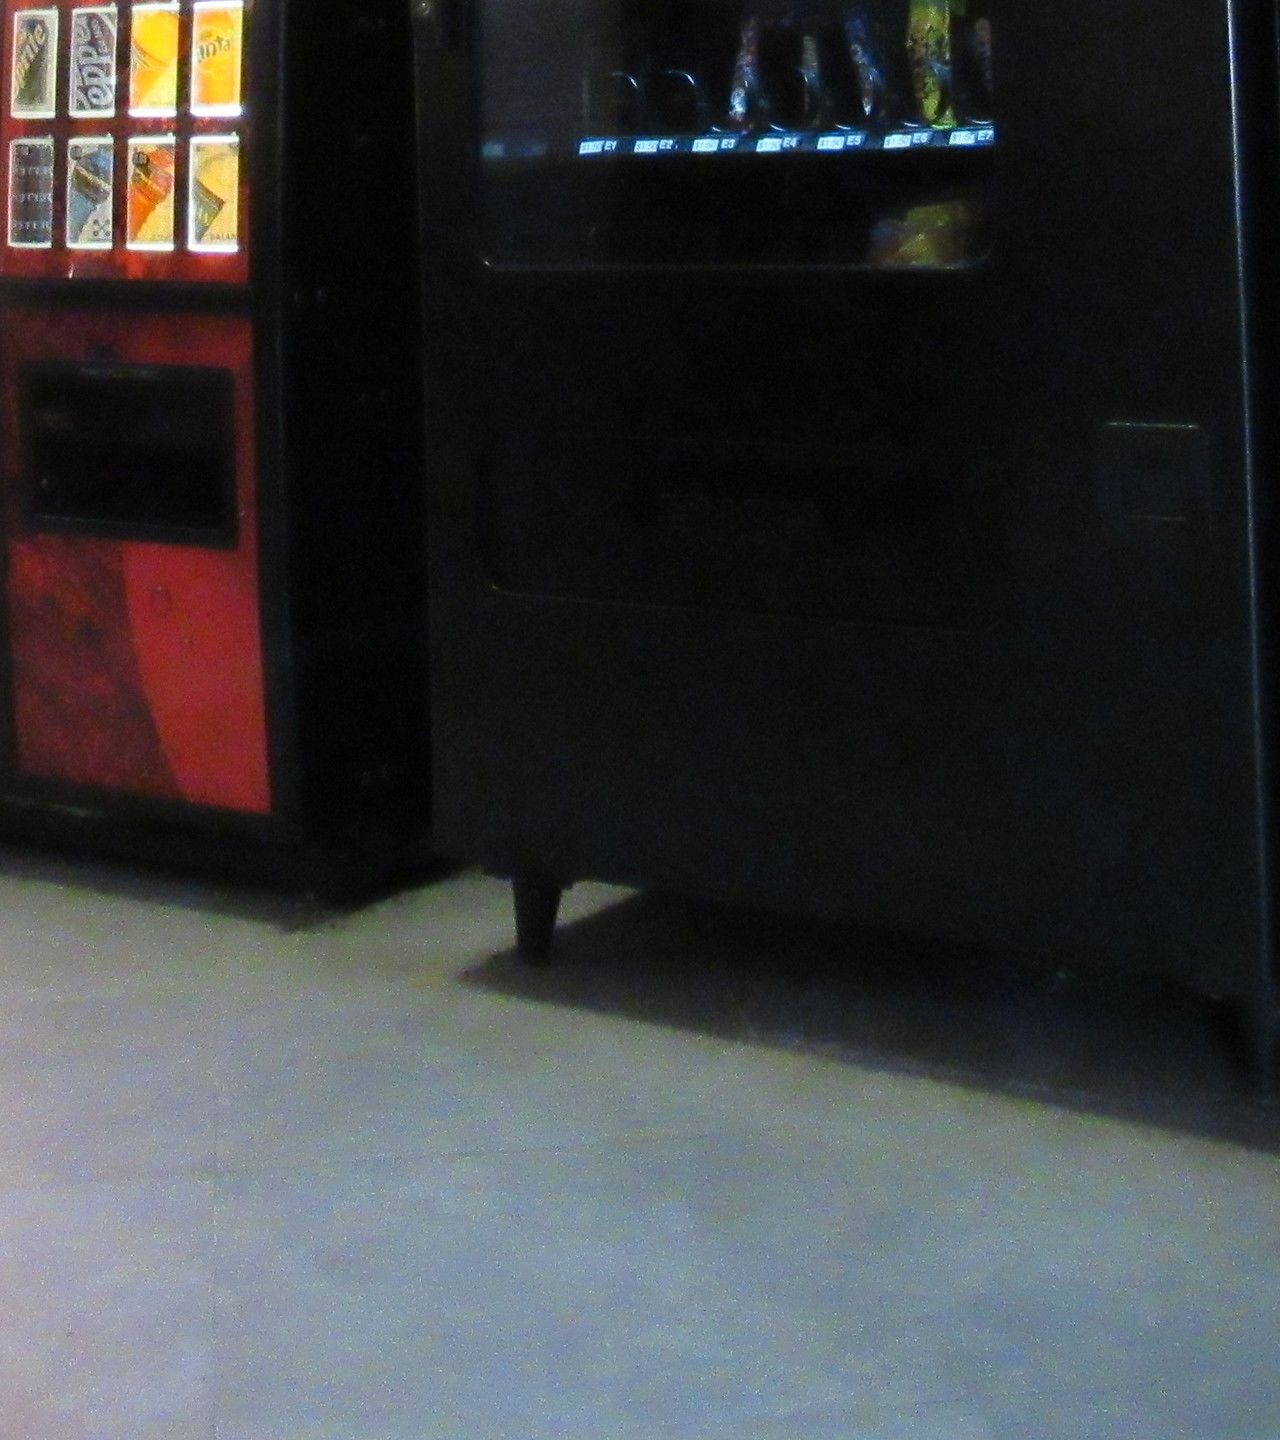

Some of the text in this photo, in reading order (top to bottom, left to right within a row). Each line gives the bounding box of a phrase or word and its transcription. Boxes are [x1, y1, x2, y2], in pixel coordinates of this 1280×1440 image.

[846, 135, 861, 146] E5
[913, 132, 927, 143] E6
[977, 130, 992, 141] E7
[604, 140, 617, 150] E1
[659, 140, 674, 150] E2
[720, 139, 736, 149] E3
[782, 138, 797, 148] E4
